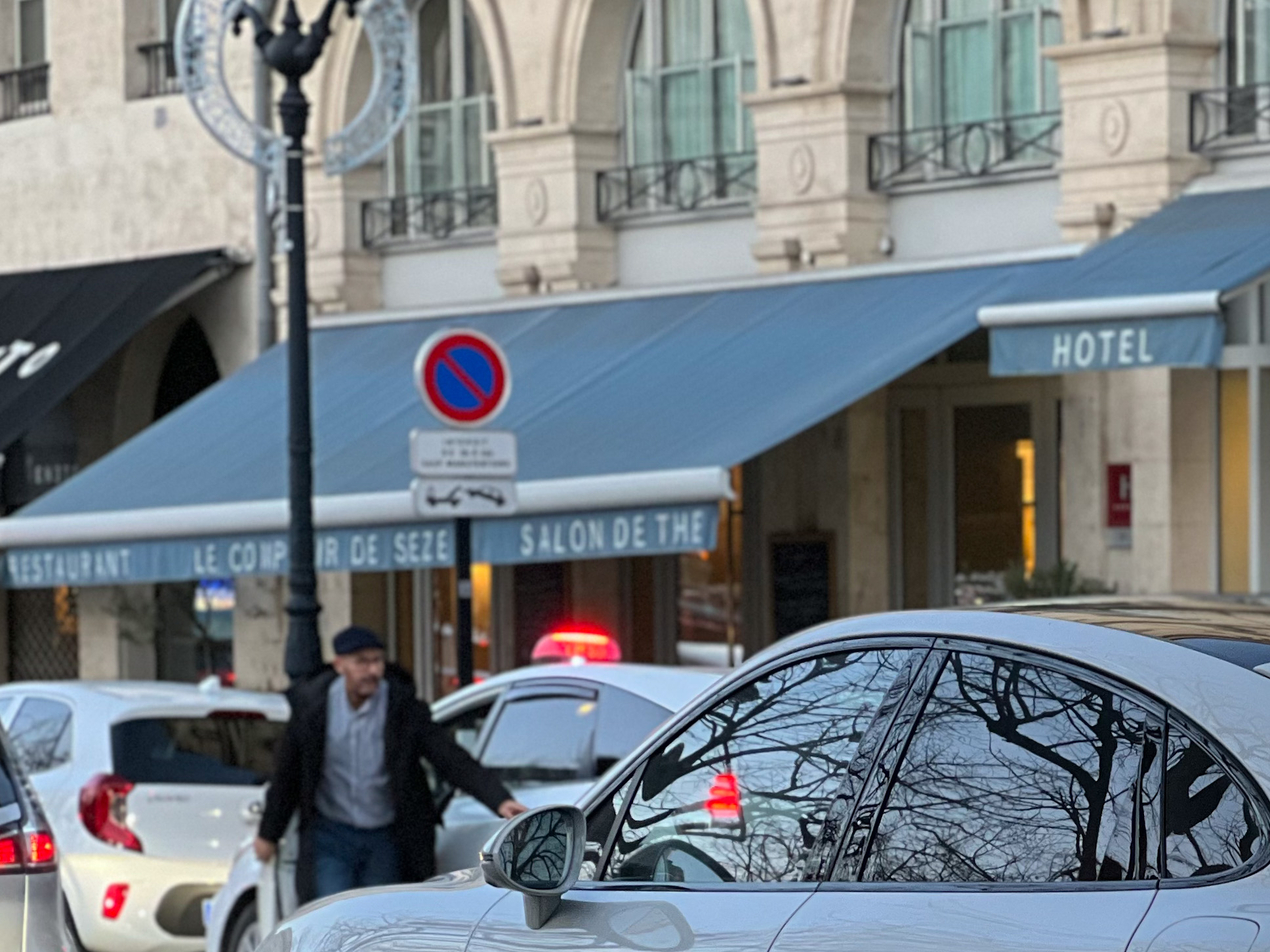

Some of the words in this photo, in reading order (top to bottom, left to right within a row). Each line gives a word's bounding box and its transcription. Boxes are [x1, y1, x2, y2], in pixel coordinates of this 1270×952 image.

[1052, 327, 1154, 368] HOTEL
[193, 542, 219, 574] LE
[227, 535, 339, 573] COMPIR
[350, 533, 379, 566] DE
[393, 529, 448, 564] SEZE
[520, 518, 605, 557] SALON
[612, 514, 647, 549] DE
[655, 508, 705, 545] THE
[7, 548, 131, 585] RESTAURANT
